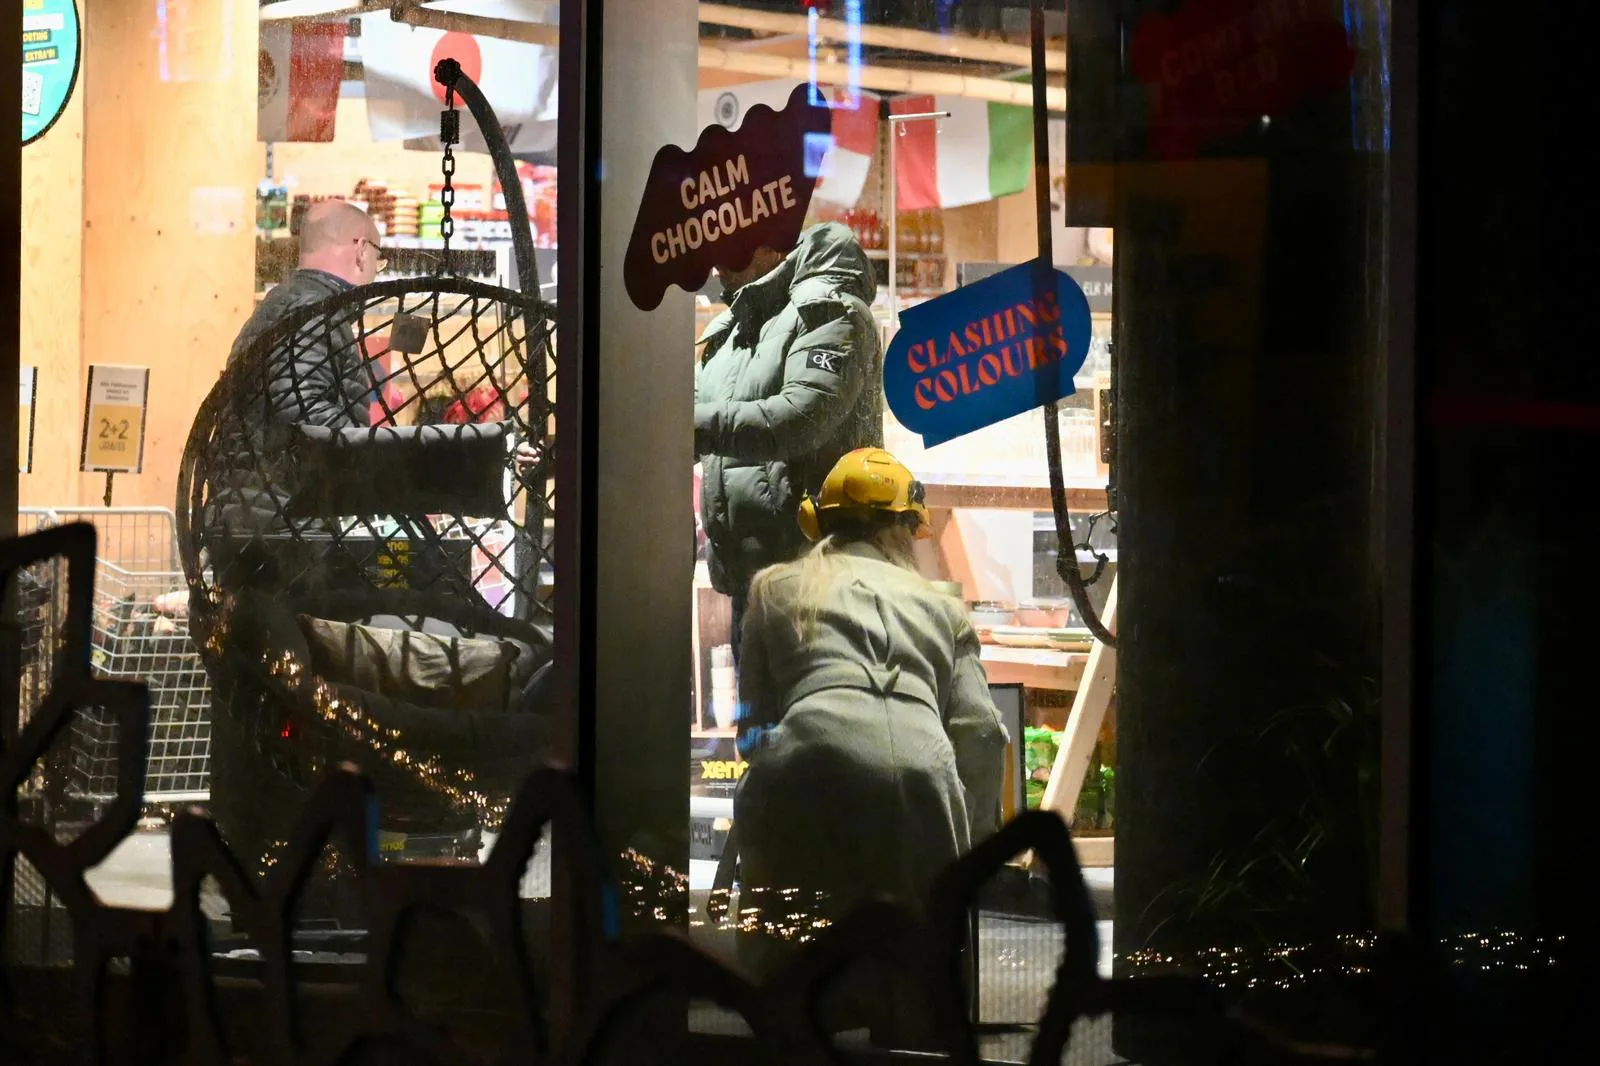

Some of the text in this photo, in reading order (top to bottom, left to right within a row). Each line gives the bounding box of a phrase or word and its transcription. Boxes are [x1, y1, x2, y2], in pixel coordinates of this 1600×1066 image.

[650, 174, 797, 265] CHOCOLATE
[680, 153, 750, 210] CALM
[907, 291, 1062, 374] CLASHING
[914, 325, 1068, 410] COLOURS
[99, 418, 129, 440] 2+2
